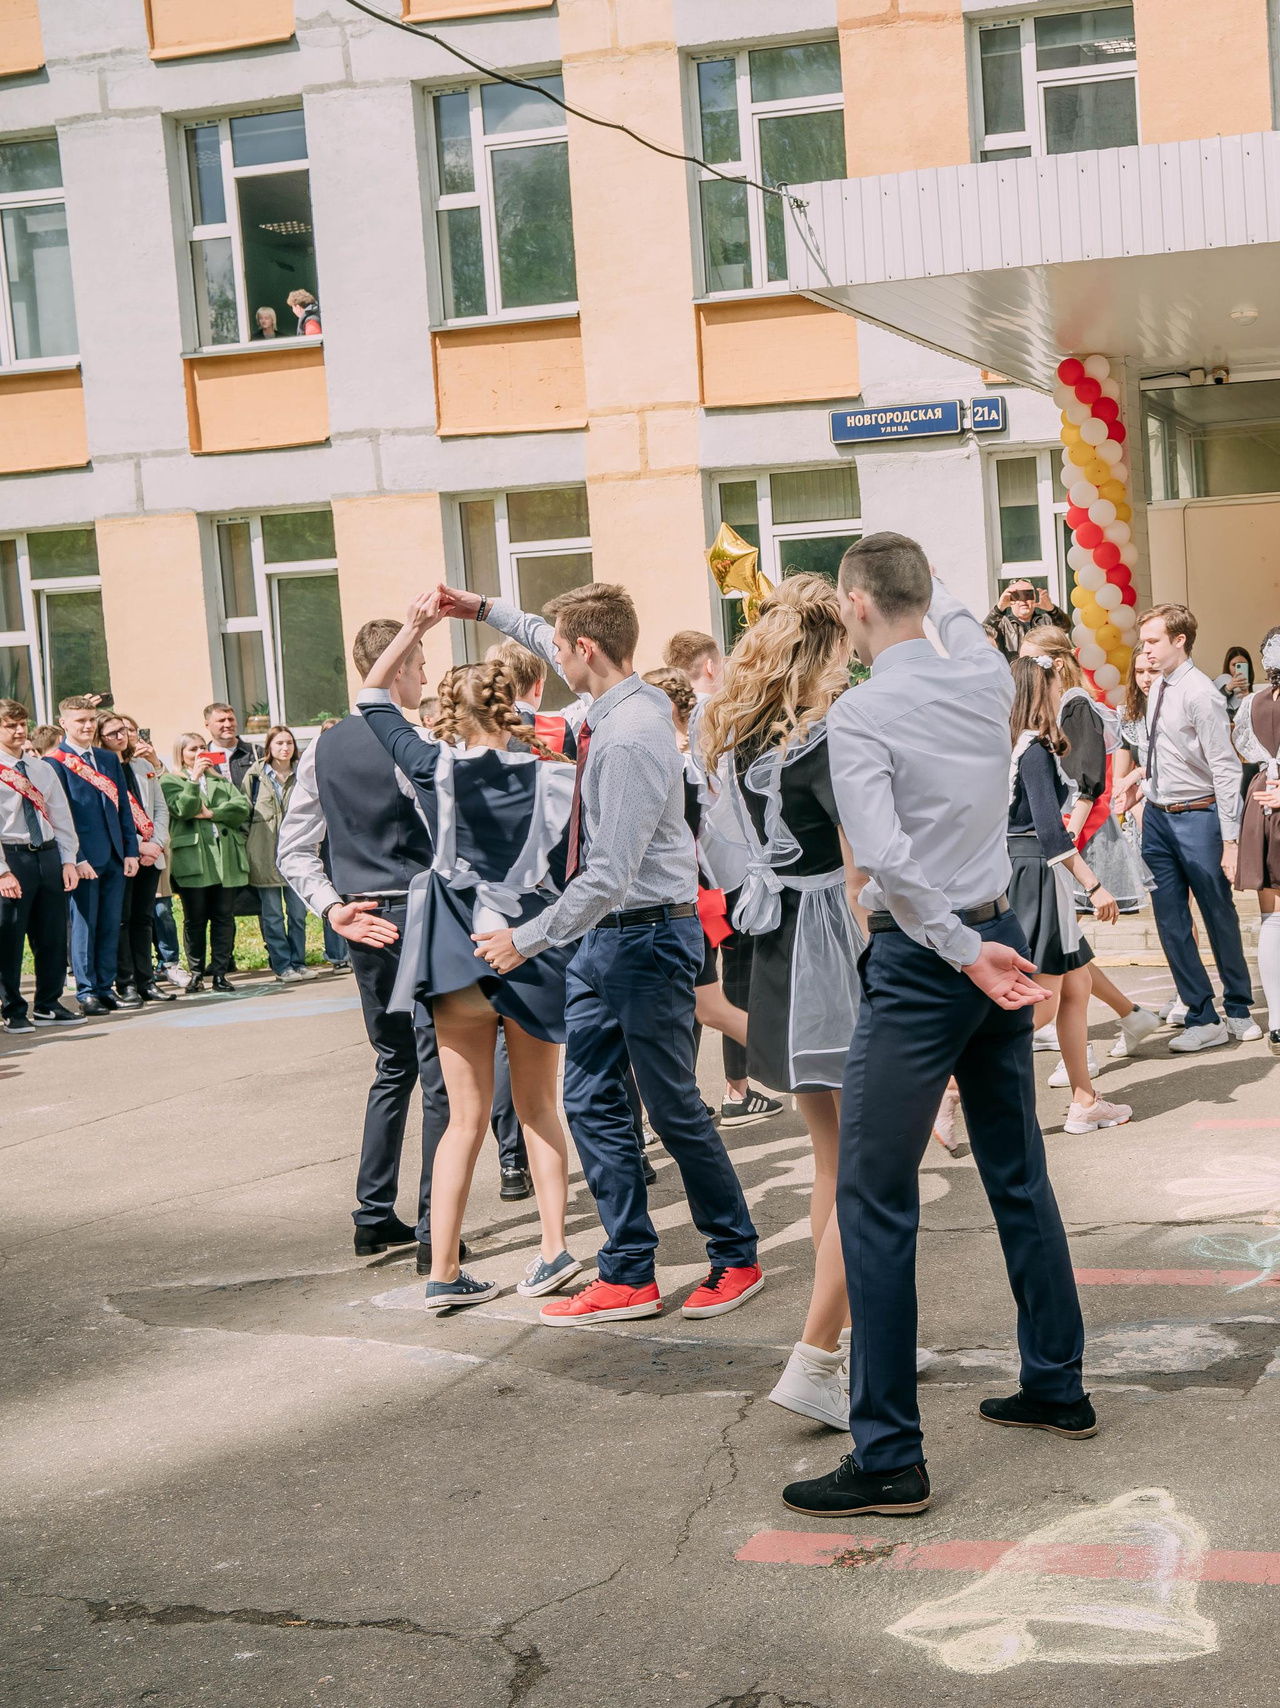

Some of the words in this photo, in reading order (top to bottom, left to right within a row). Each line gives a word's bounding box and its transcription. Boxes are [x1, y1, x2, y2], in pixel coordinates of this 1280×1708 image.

[846, 407, 943, 428] НОВГОРОДСКАЯ
[973, 406, 999, 422] 21А
[880, 425, 909, 434] УЛИЦА
